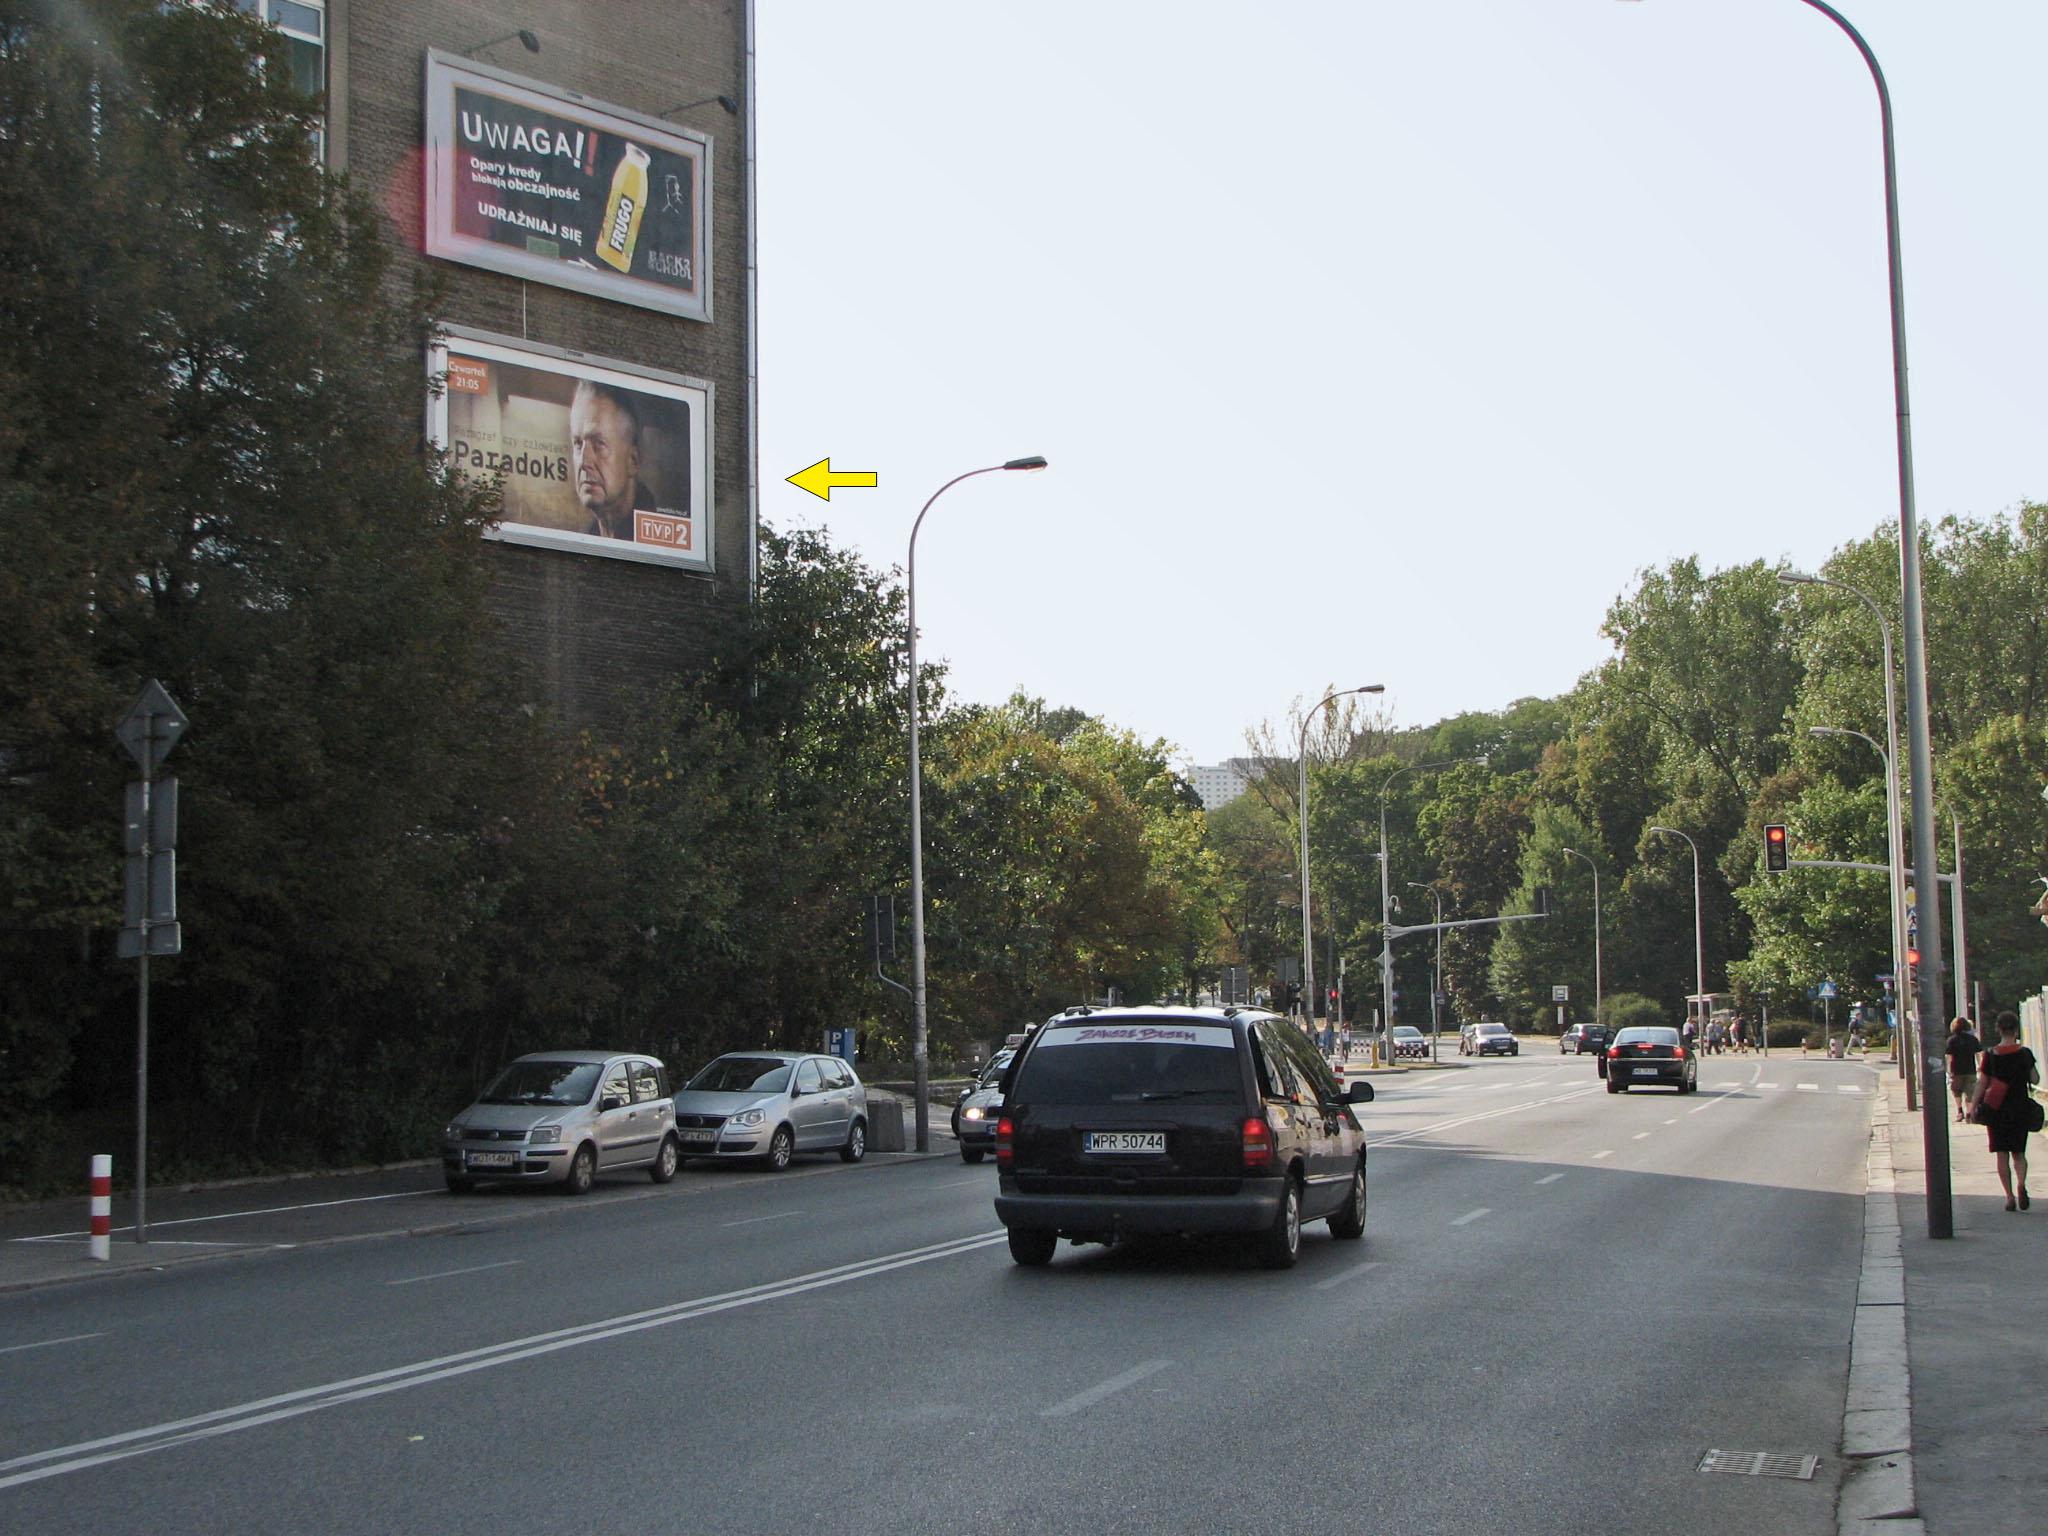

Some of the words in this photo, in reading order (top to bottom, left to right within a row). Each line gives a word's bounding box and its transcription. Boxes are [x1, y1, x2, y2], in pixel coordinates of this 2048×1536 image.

[470, 157, 505, 176] Opary
[508, 163, 541, 182] kredy
[507, 178, 581, 201] obczajność
[478, 201, 557, 235] UDRAŻNIAJ
[560, 226, 583, 247] SIĘ
[610, 198, 634, 252] FRUGO
[832, 1031, 842, 1044] P
[1092, 1134, 1118, 1149] WPR
[1121, 1134, 1163, 1149] 50744
